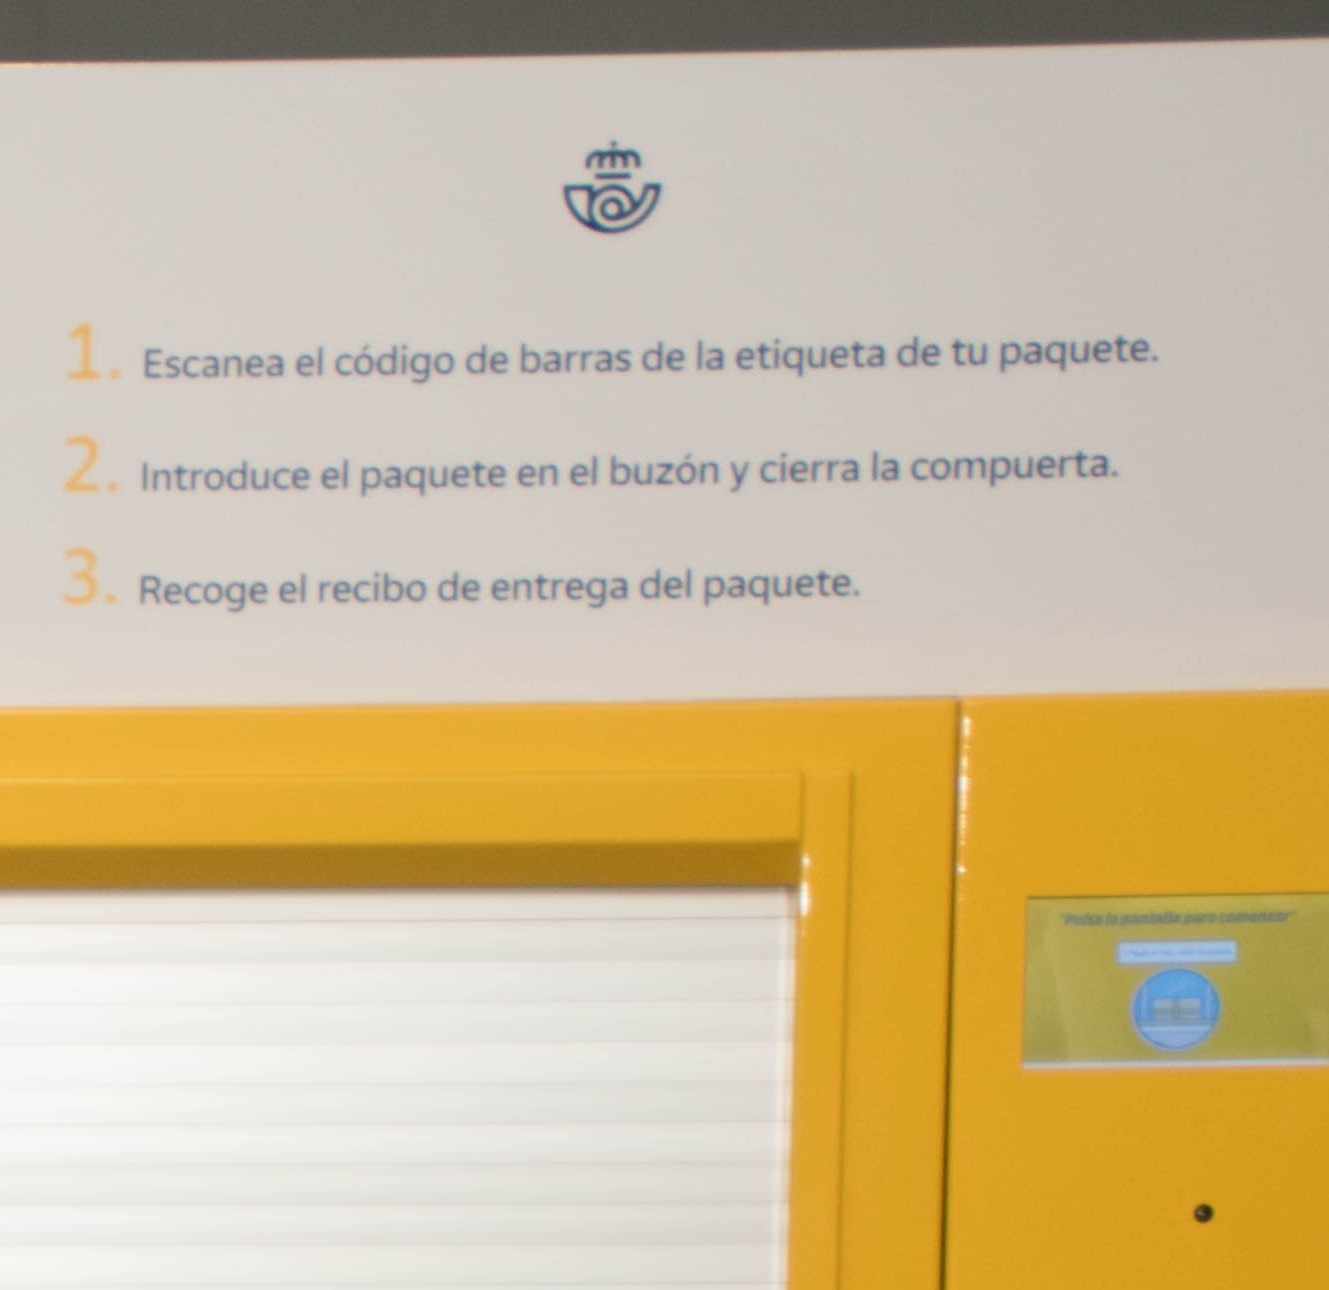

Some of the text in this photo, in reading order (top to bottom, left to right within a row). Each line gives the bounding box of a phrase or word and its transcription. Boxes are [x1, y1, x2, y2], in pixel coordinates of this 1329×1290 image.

[67, 322, 1160, 385] 1. Escanea el código de barras de la etiqueta de tu paquete.
[63, 434, 1120, 497] 2. Introduce el paquete en el buzón y cierra la compuerta.
[63, 546, 861, 613] 3. Recoge el recibo de entrega del paquete.
